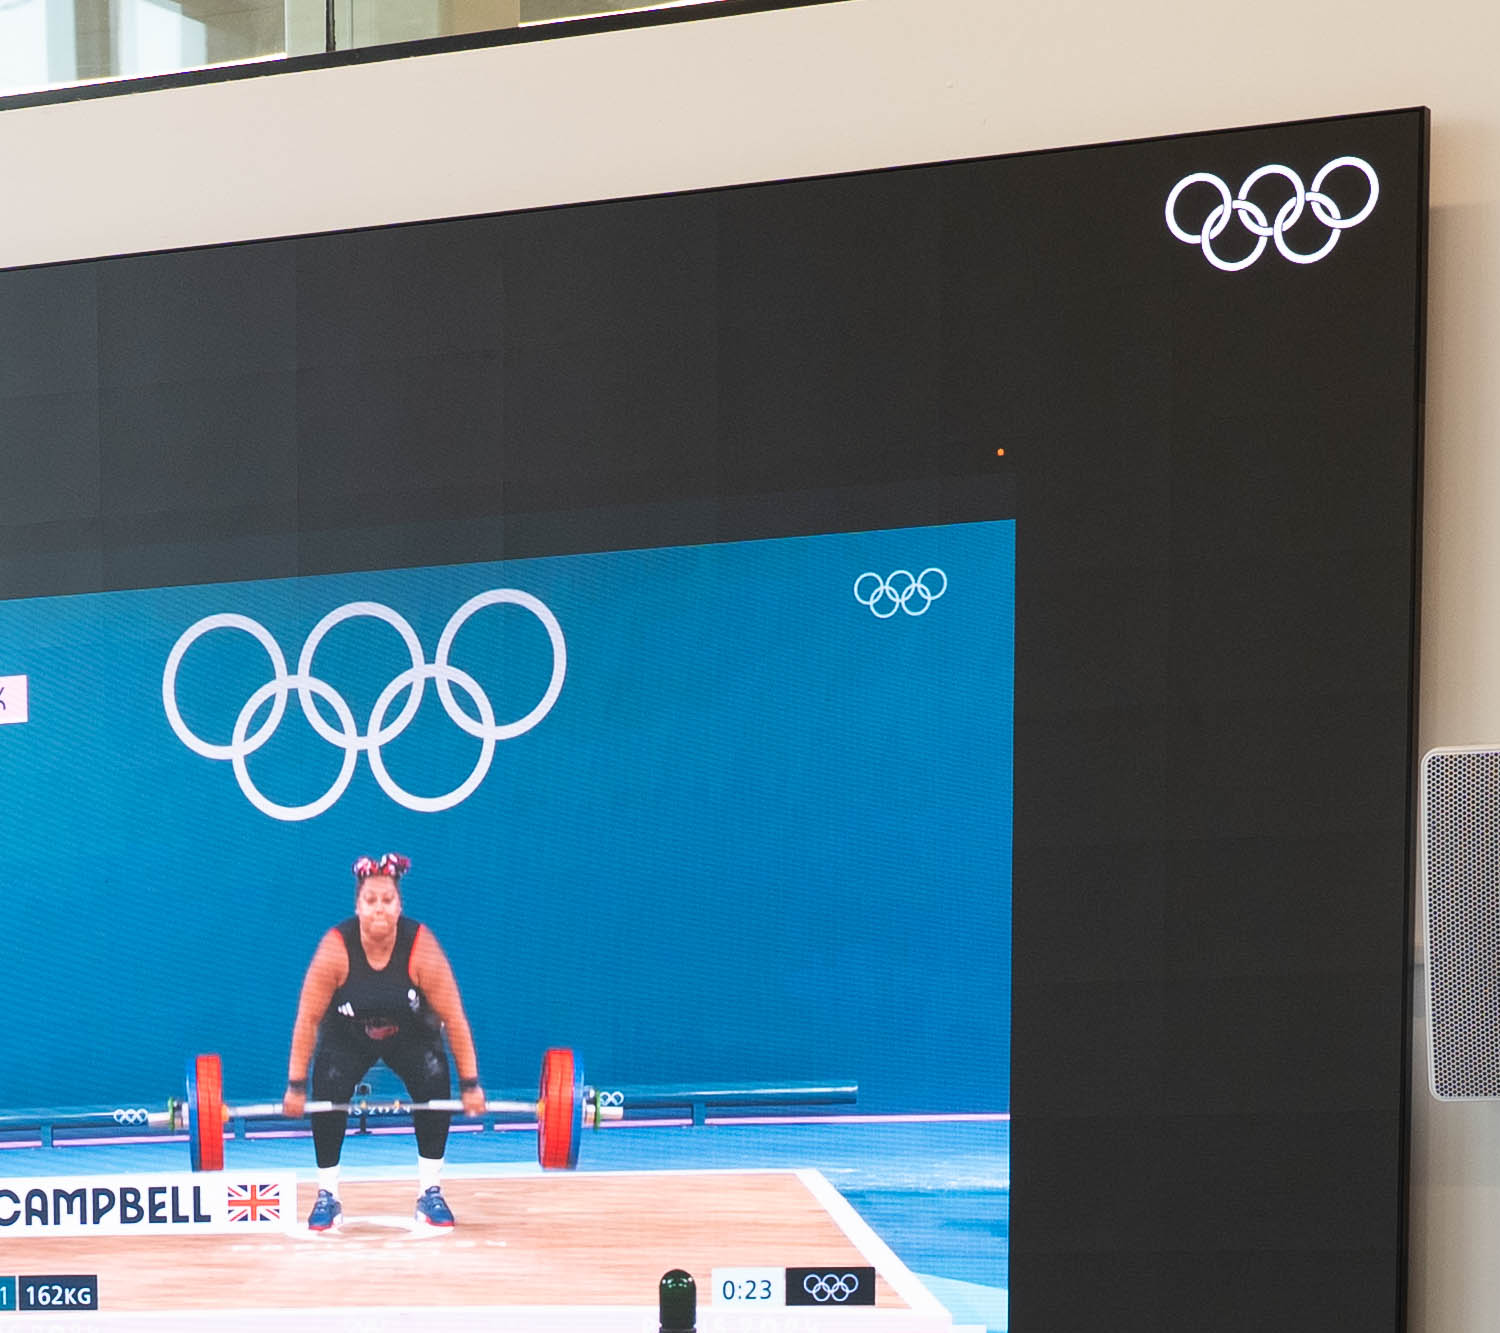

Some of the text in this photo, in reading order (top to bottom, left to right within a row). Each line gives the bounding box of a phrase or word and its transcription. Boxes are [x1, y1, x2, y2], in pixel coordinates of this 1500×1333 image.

[0, 1286, 8, 1306] 1
[25, 1284, 92, 1306] 162KG
[722, 1279, 772, 1301] 0:23
